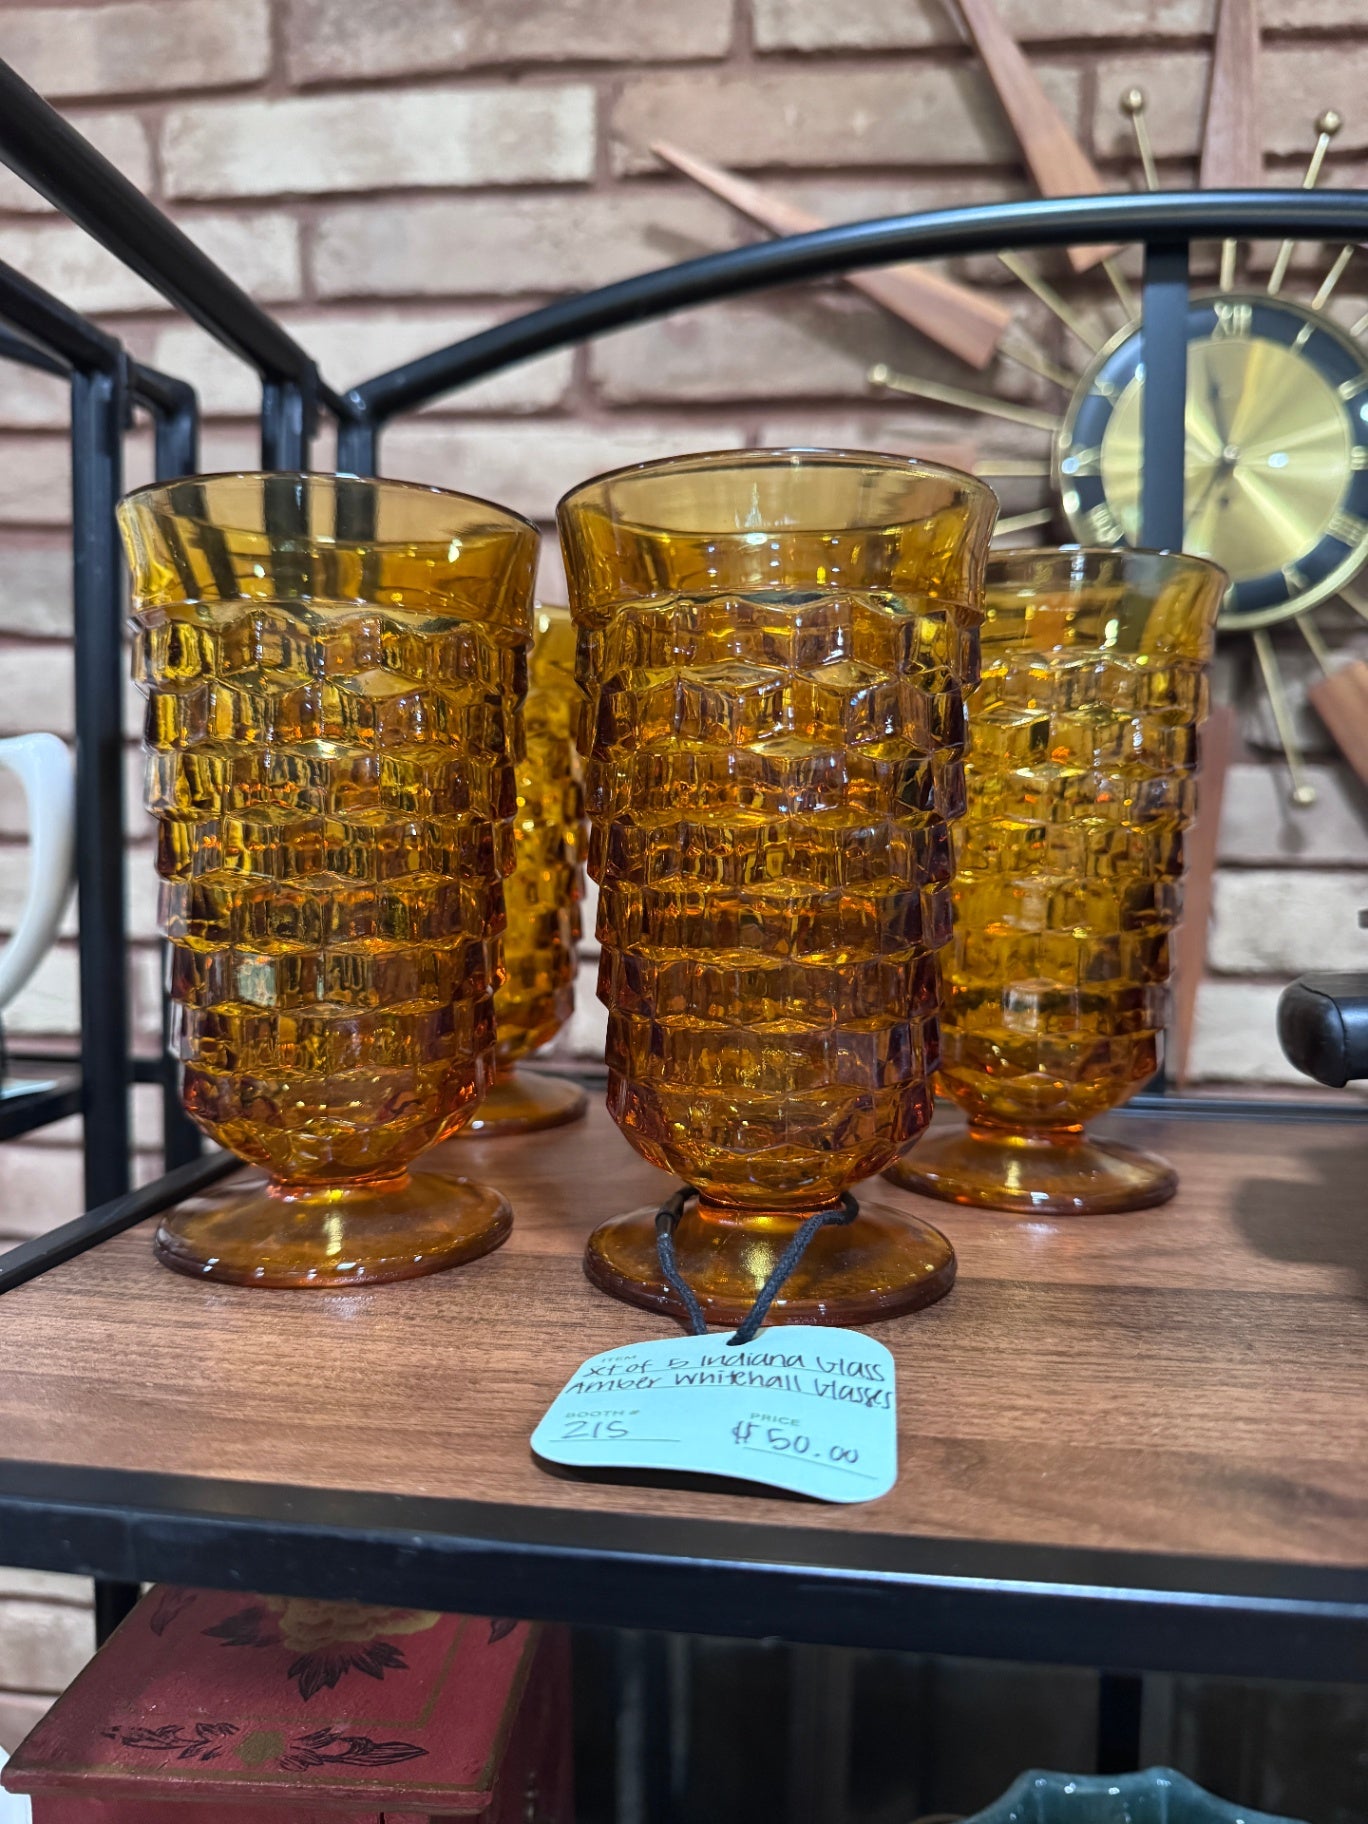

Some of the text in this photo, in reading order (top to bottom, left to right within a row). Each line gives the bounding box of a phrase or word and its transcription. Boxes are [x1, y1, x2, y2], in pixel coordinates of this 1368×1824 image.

[625, 1359, 652, 1374] of
[667, 1358, 689, 1370] 5
[701, 1352, 806, 1368] Indiana
[816, 1356, 885, 1382] Glass
[565, 1376, 662, 1394] Amber
[750, 1412, 801, 1427] PRICE
